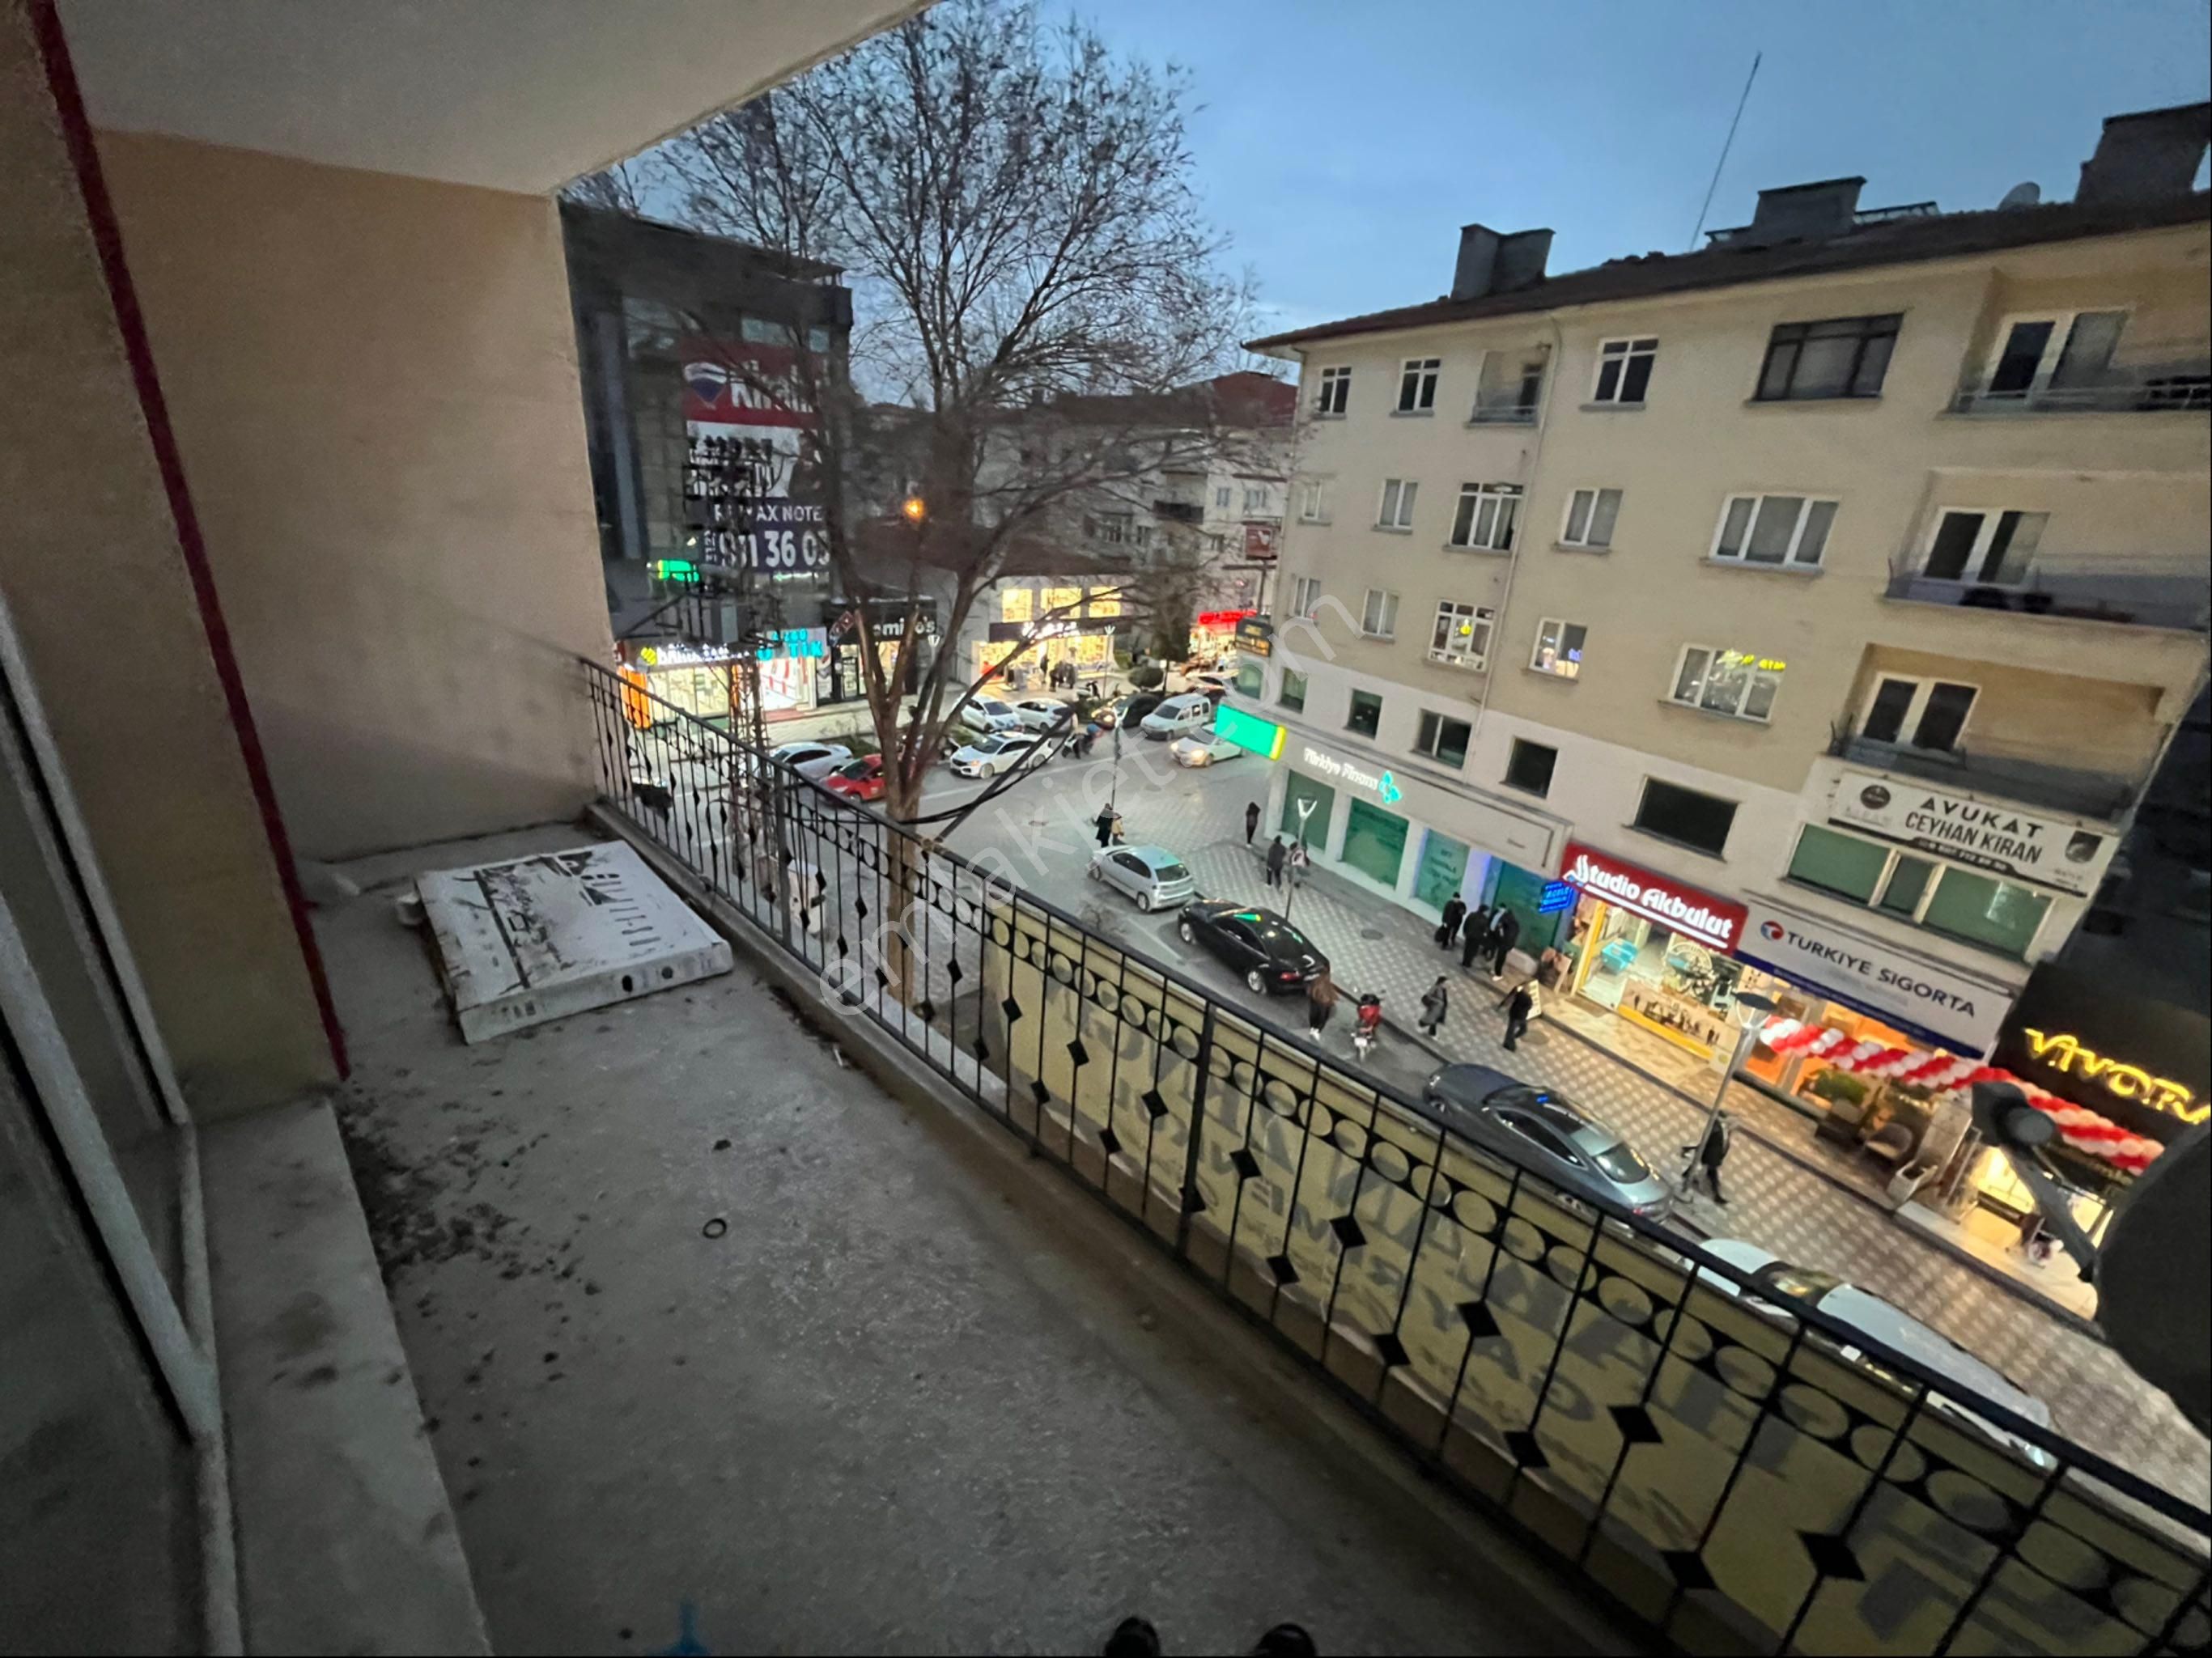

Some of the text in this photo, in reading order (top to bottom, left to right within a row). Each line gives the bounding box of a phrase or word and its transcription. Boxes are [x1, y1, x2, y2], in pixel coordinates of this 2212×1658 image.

[765, 530, 796, 567] 36
[1905, 811, 1979, 846] CEYHAN
[1920, 796, 2044, 839] AVUKAT
[1562, 854, 1641, 901] Studio
[1641, 888, 1733, 939] Akbulut
